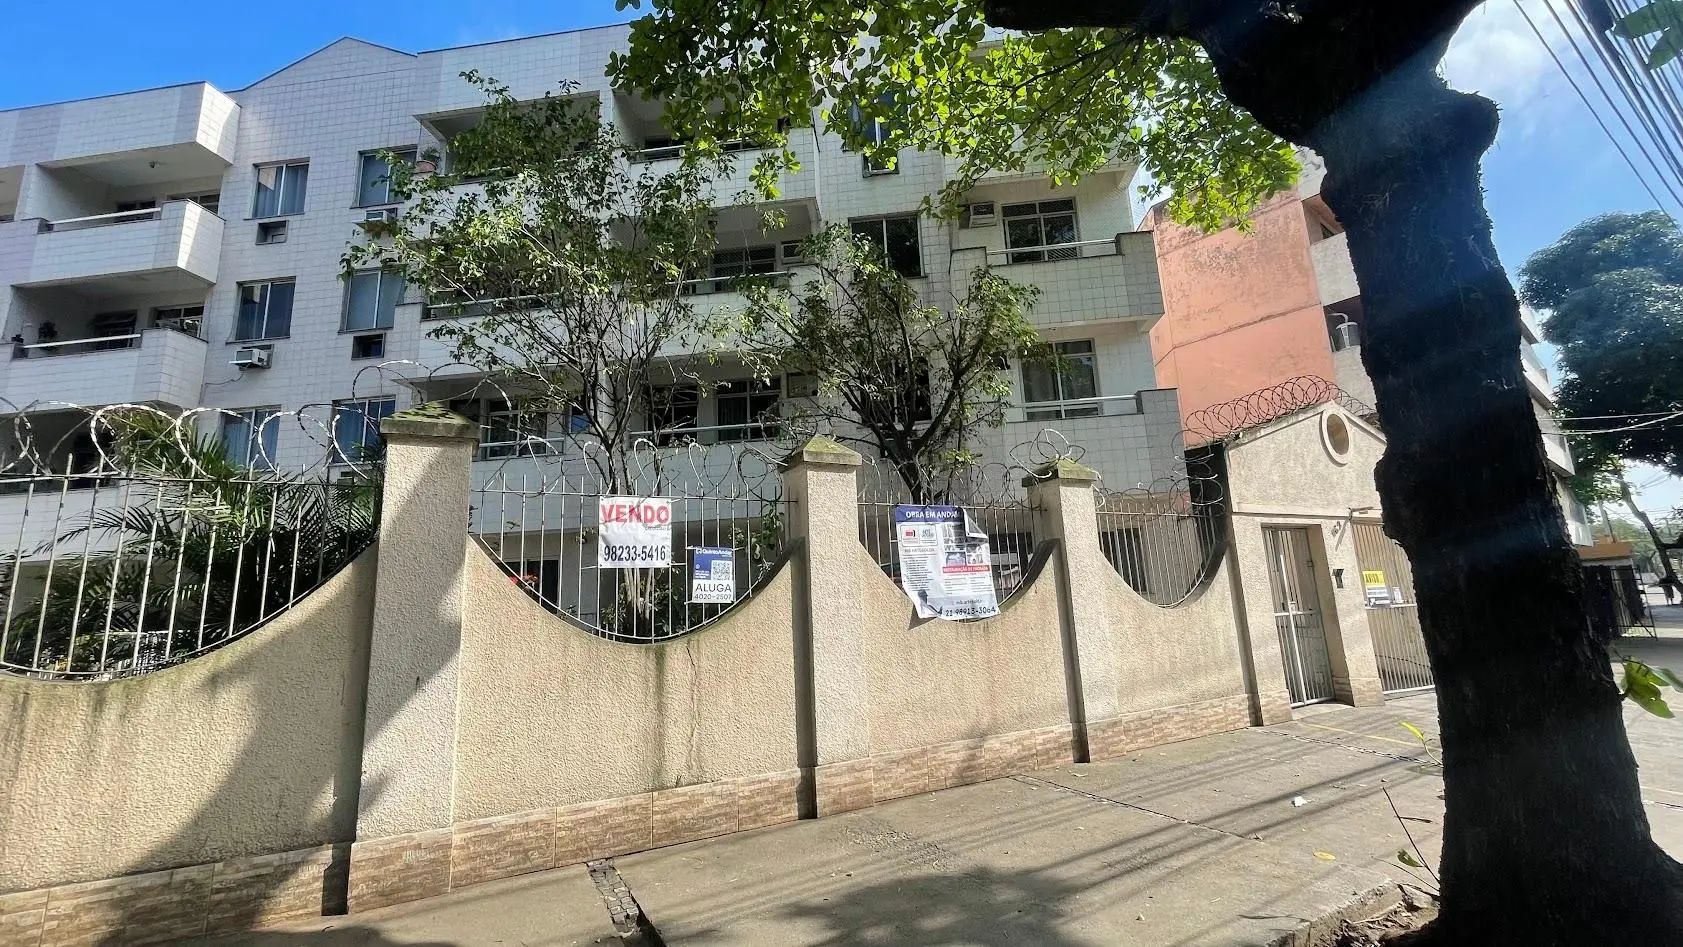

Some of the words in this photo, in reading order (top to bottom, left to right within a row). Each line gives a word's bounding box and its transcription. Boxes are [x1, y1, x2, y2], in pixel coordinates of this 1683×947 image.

[601, 504, 670, 524] VENDO
[604, 545, 666, 561] 98233-5416
[696, 584, 732, 592] ALUGA
